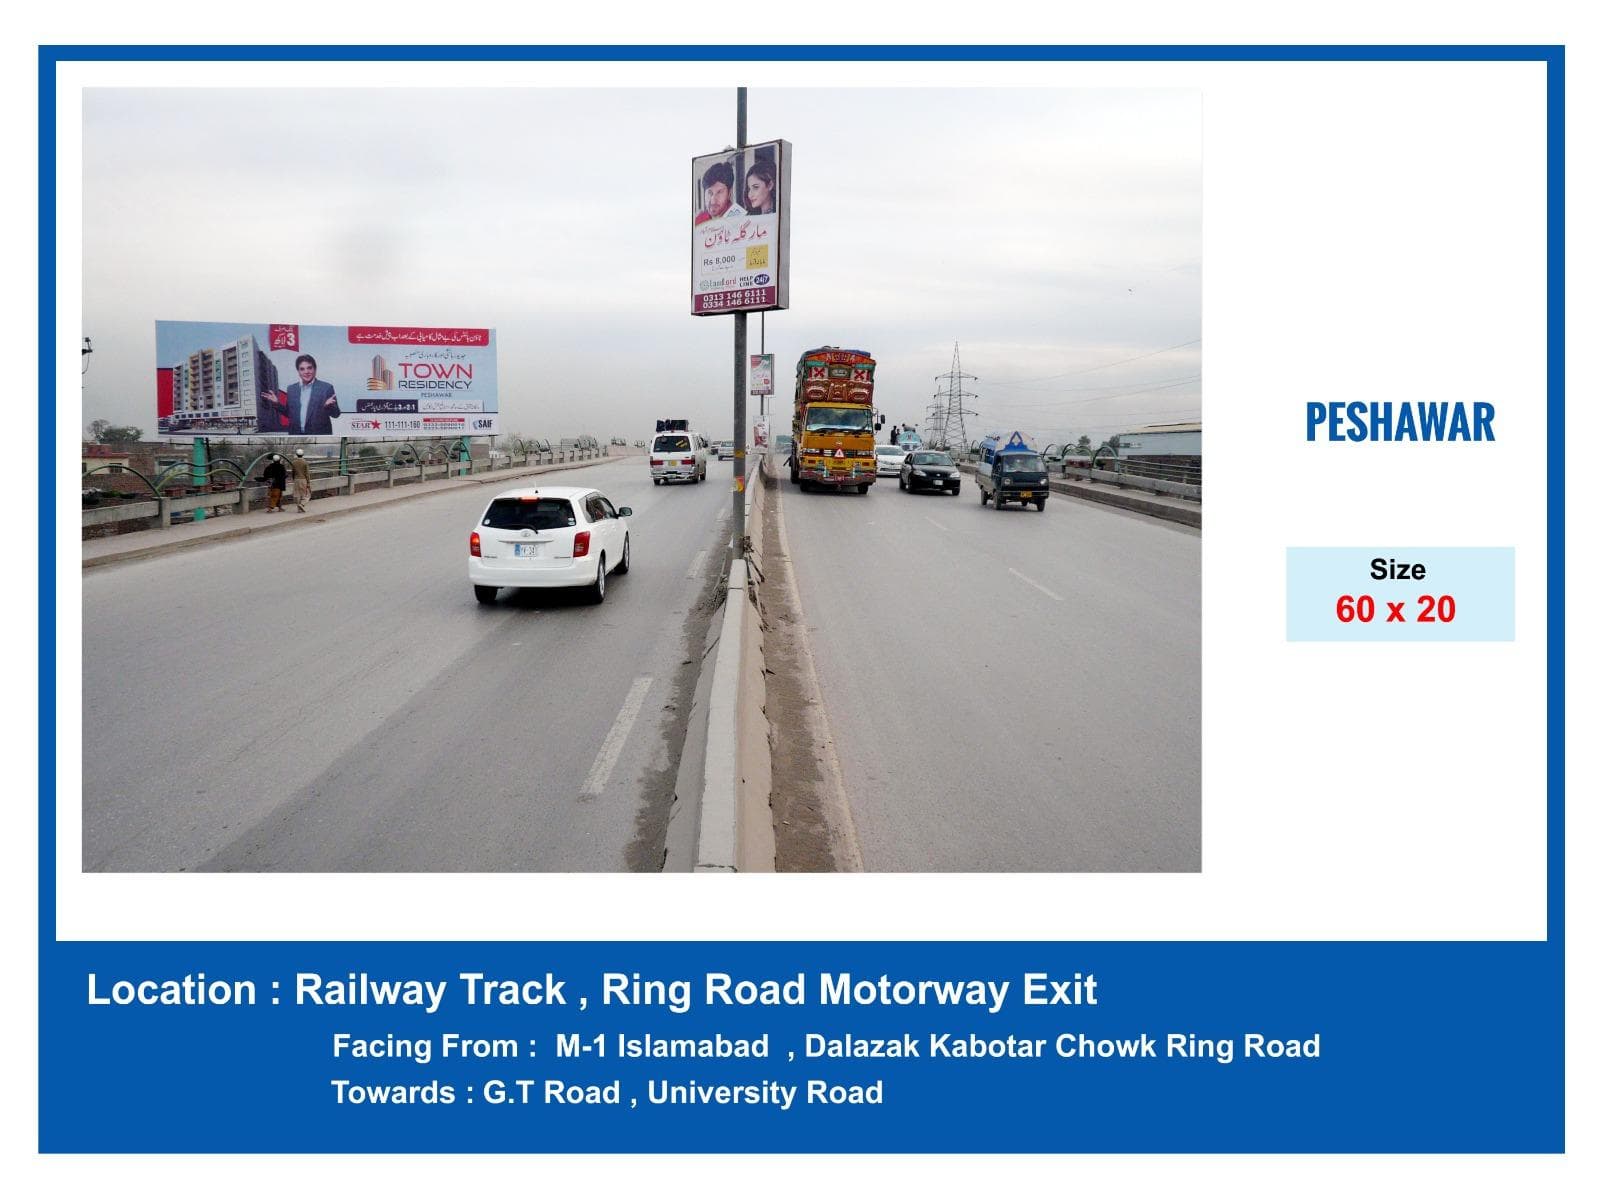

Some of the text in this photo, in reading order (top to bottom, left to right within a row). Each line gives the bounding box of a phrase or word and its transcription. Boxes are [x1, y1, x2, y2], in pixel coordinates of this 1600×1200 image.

[715, 255, 736, 265] 8,000
[703, 289, 767, 302] 0313 146 6111
[702, 300, 724, 309] 0334
[744, 296, 767, 304] 6111
[287, 333, 296, 346] 3
[398, 363, 473, 379] TOWN
[398, 380, 472, 390] RESIDENCY
[351, 421, 371, 429] STAR
[478, 419, 493, 429] SAIF
